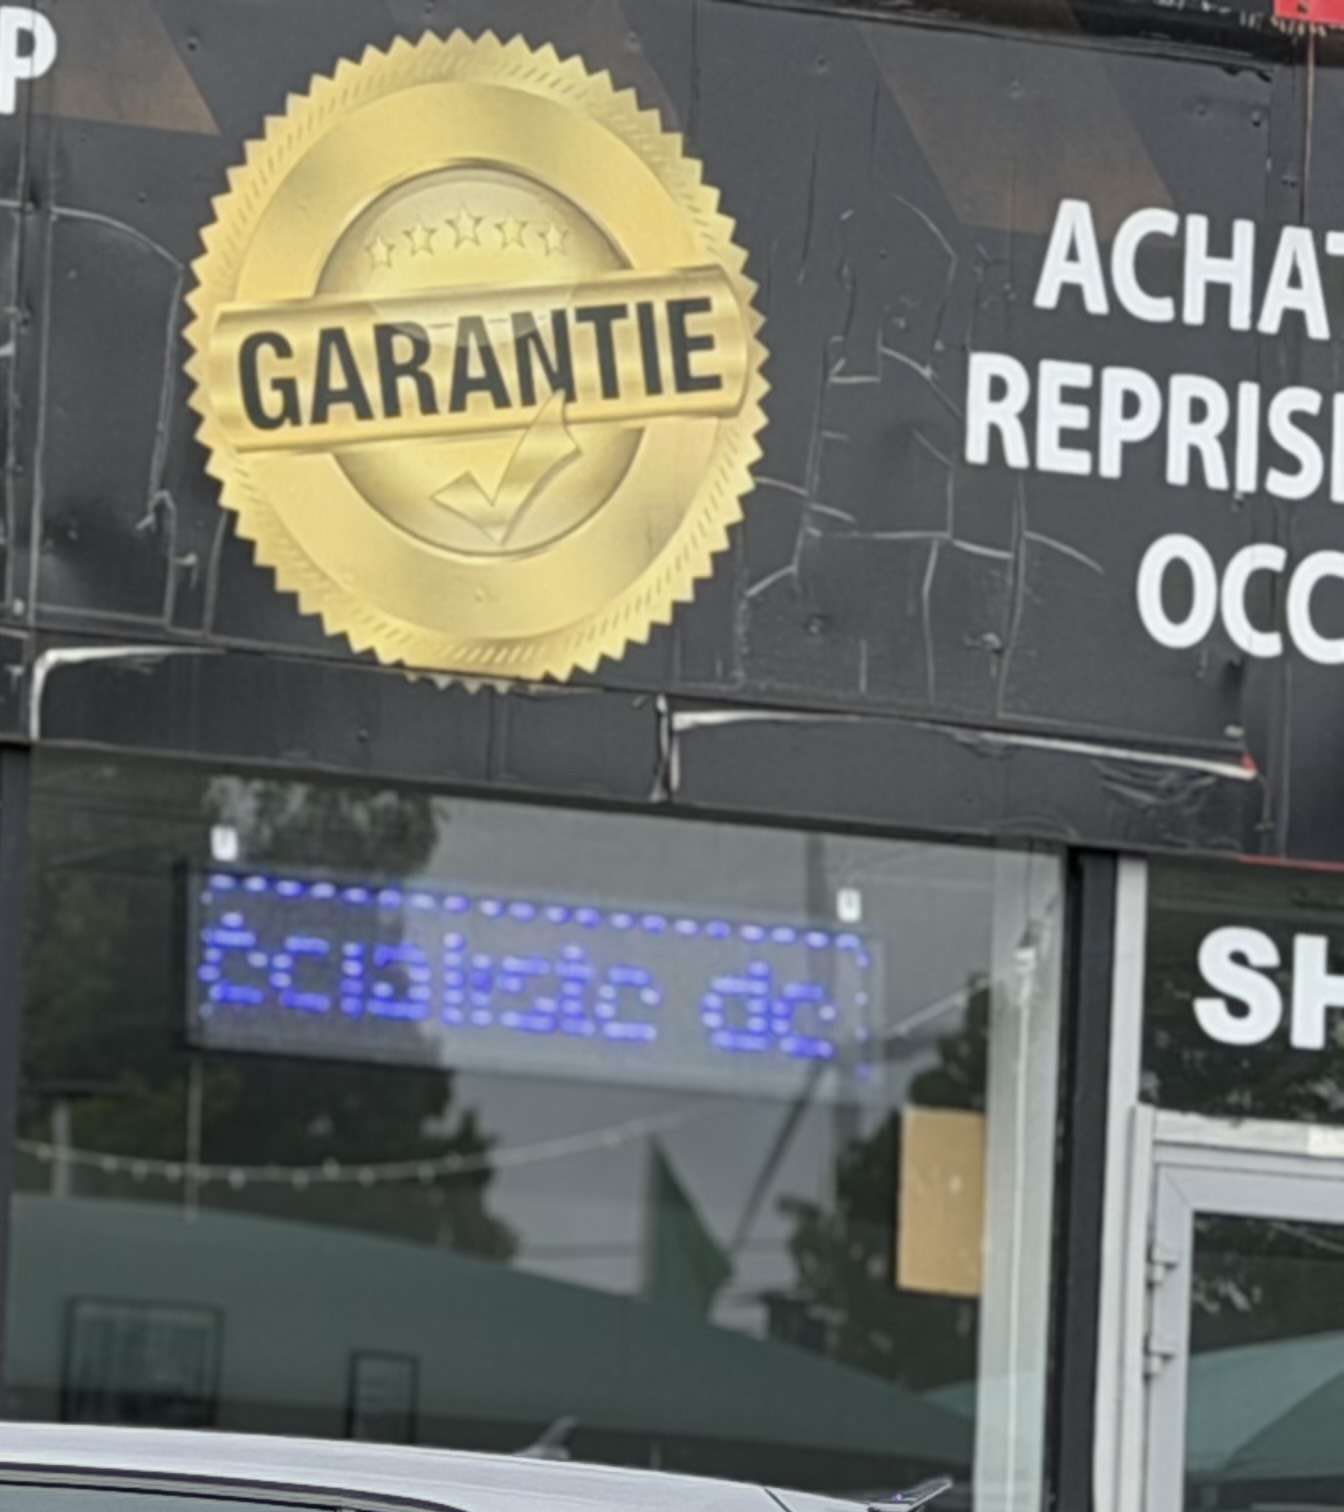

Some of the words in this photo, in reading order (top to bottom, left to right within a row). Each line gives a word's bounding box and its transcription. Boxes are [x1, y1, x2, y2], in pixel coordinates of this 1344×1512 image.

[1033, 198, 1344, 340] ACHA
[237, 294, 724, 430] GARANTIE
[965, 350, 1344, 503] REPRIS
